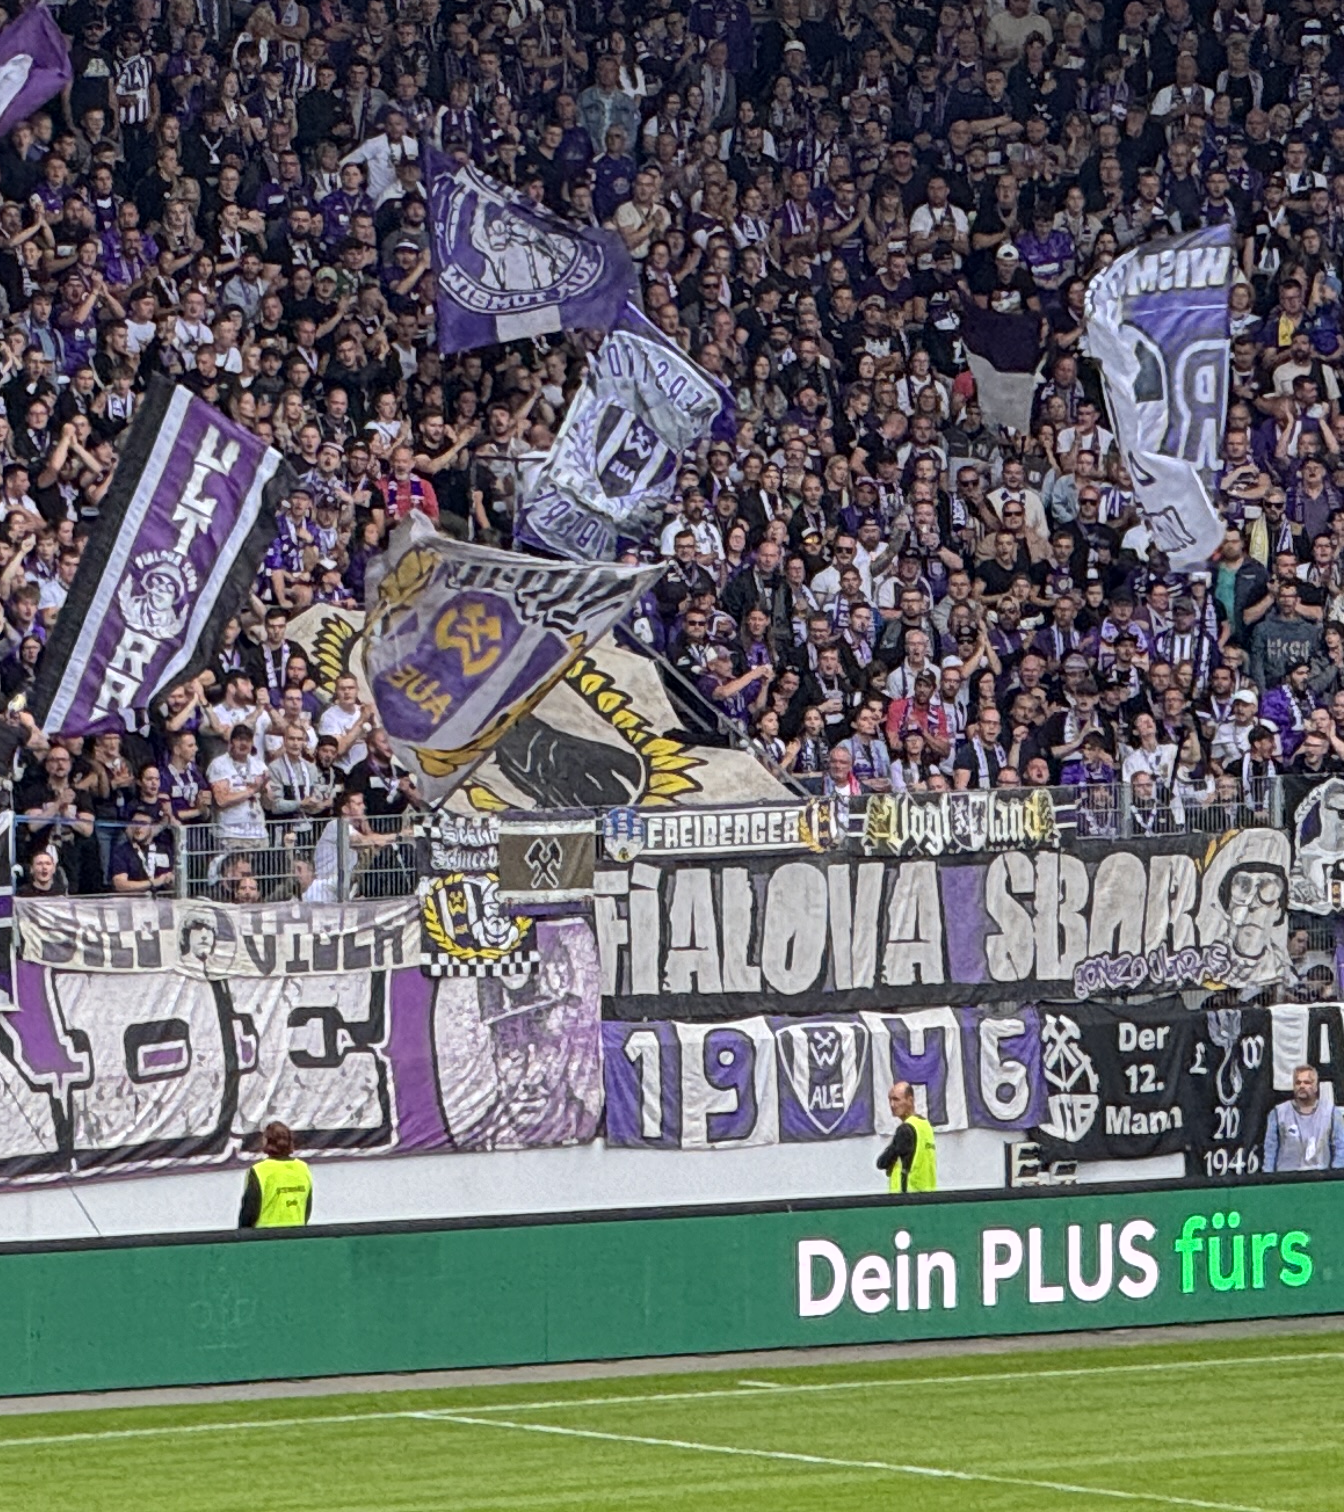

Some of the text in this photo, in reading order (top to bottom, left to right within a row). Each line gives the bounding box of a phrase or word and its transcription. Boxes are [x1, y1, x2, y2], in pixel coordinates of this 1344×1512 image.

[647, 811, 801, 849] FREIBERGER
[1118, 1021, 1170, 1053] Der
[1125, 1064, 1165, 1094] 12.
[1105, 1104, 1184, 1136] Mann
[1204, 1145, 1260, 1178] 1946
[797, 1211, 1314, 1317] Dein PLUS fürs
